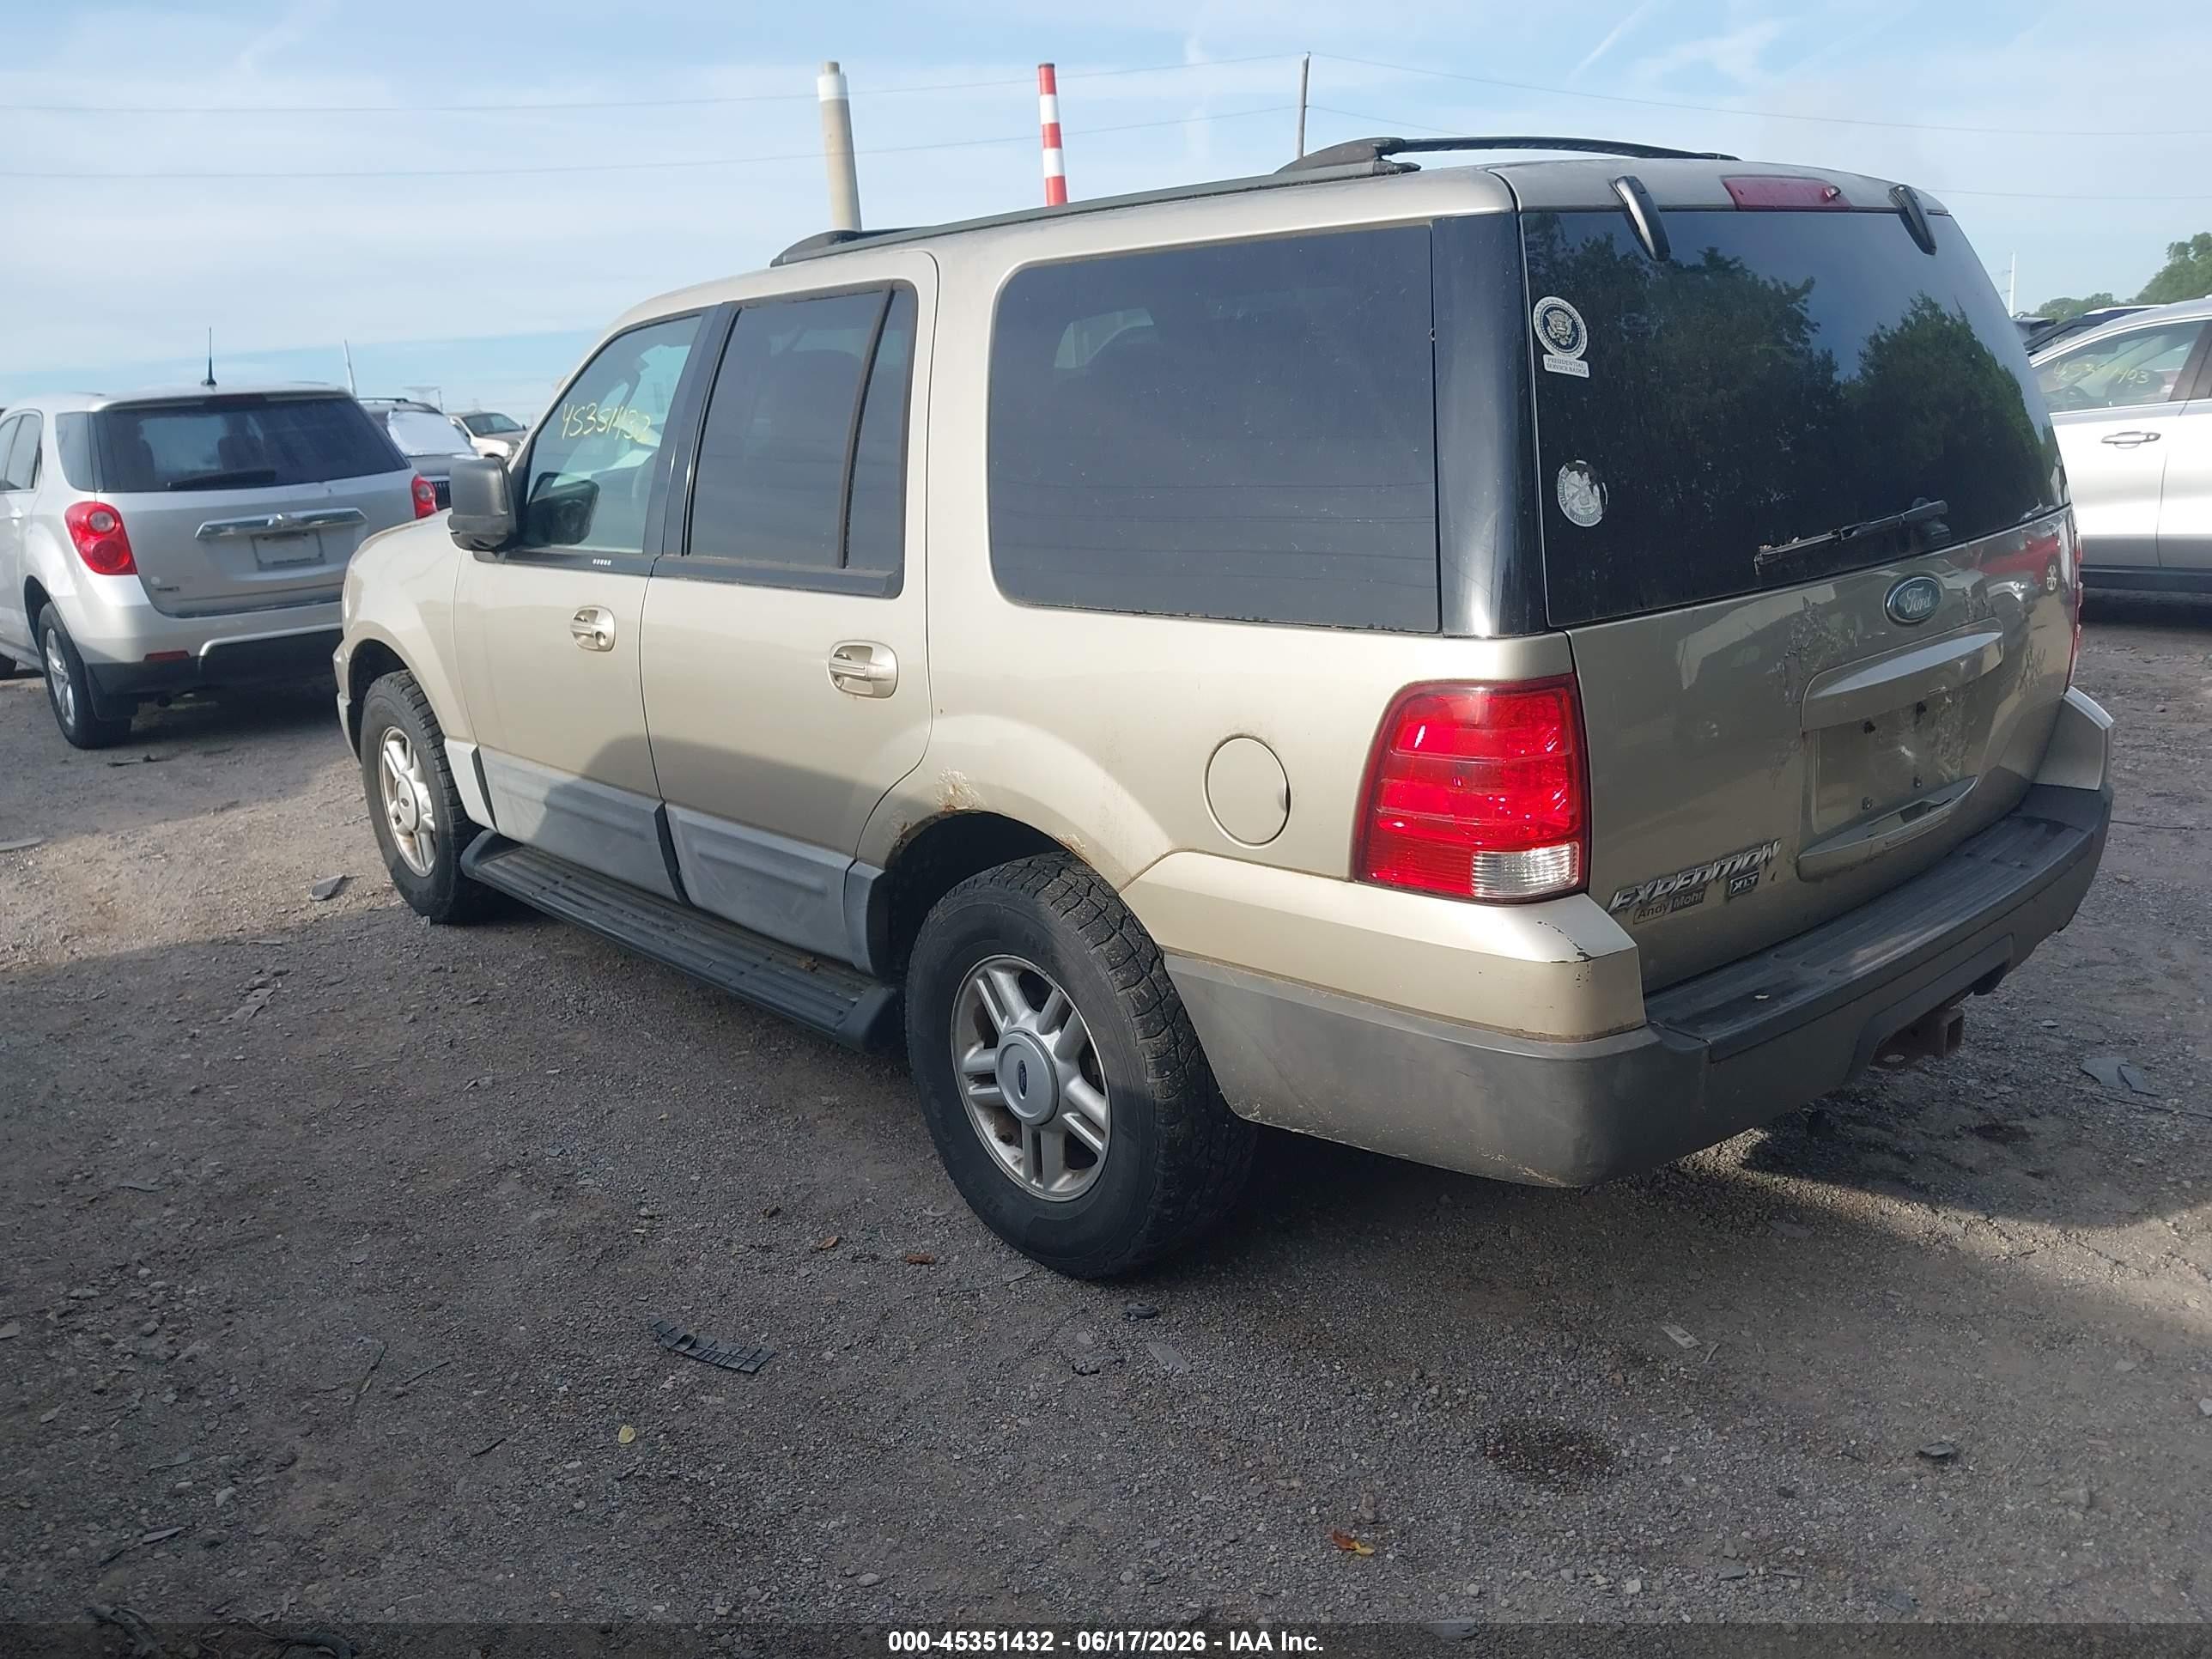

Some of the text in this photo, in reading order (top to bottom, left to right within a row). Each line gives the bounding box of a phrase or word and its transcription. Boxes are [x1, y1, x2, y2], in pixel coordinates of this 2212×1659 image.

[1905, 586, 1932, 613] Ford
[1607, 837, 1782, 915] EXPEDITION
[1733, 874, 1759, 894] XLT
[1637, 890, 1705, 921] Andy Mohr
